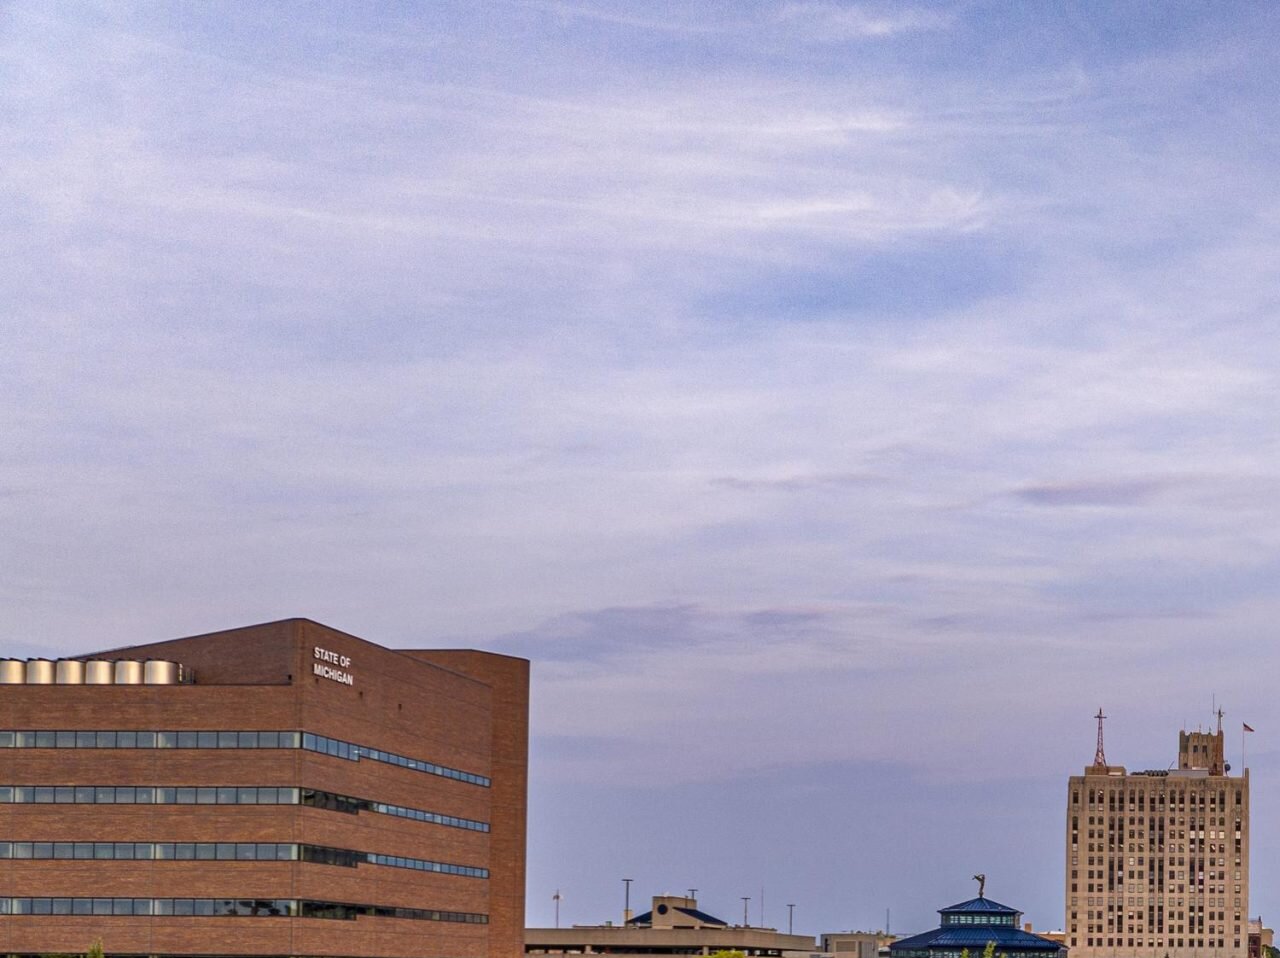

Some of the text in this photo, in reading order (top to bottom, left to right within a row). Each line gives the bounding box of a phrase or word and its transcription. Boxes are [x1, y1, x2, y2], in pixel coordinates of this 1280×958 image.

[314, 647, 351, 668] STATE OF
[314, 664, 353, 685] MICHIGAN
